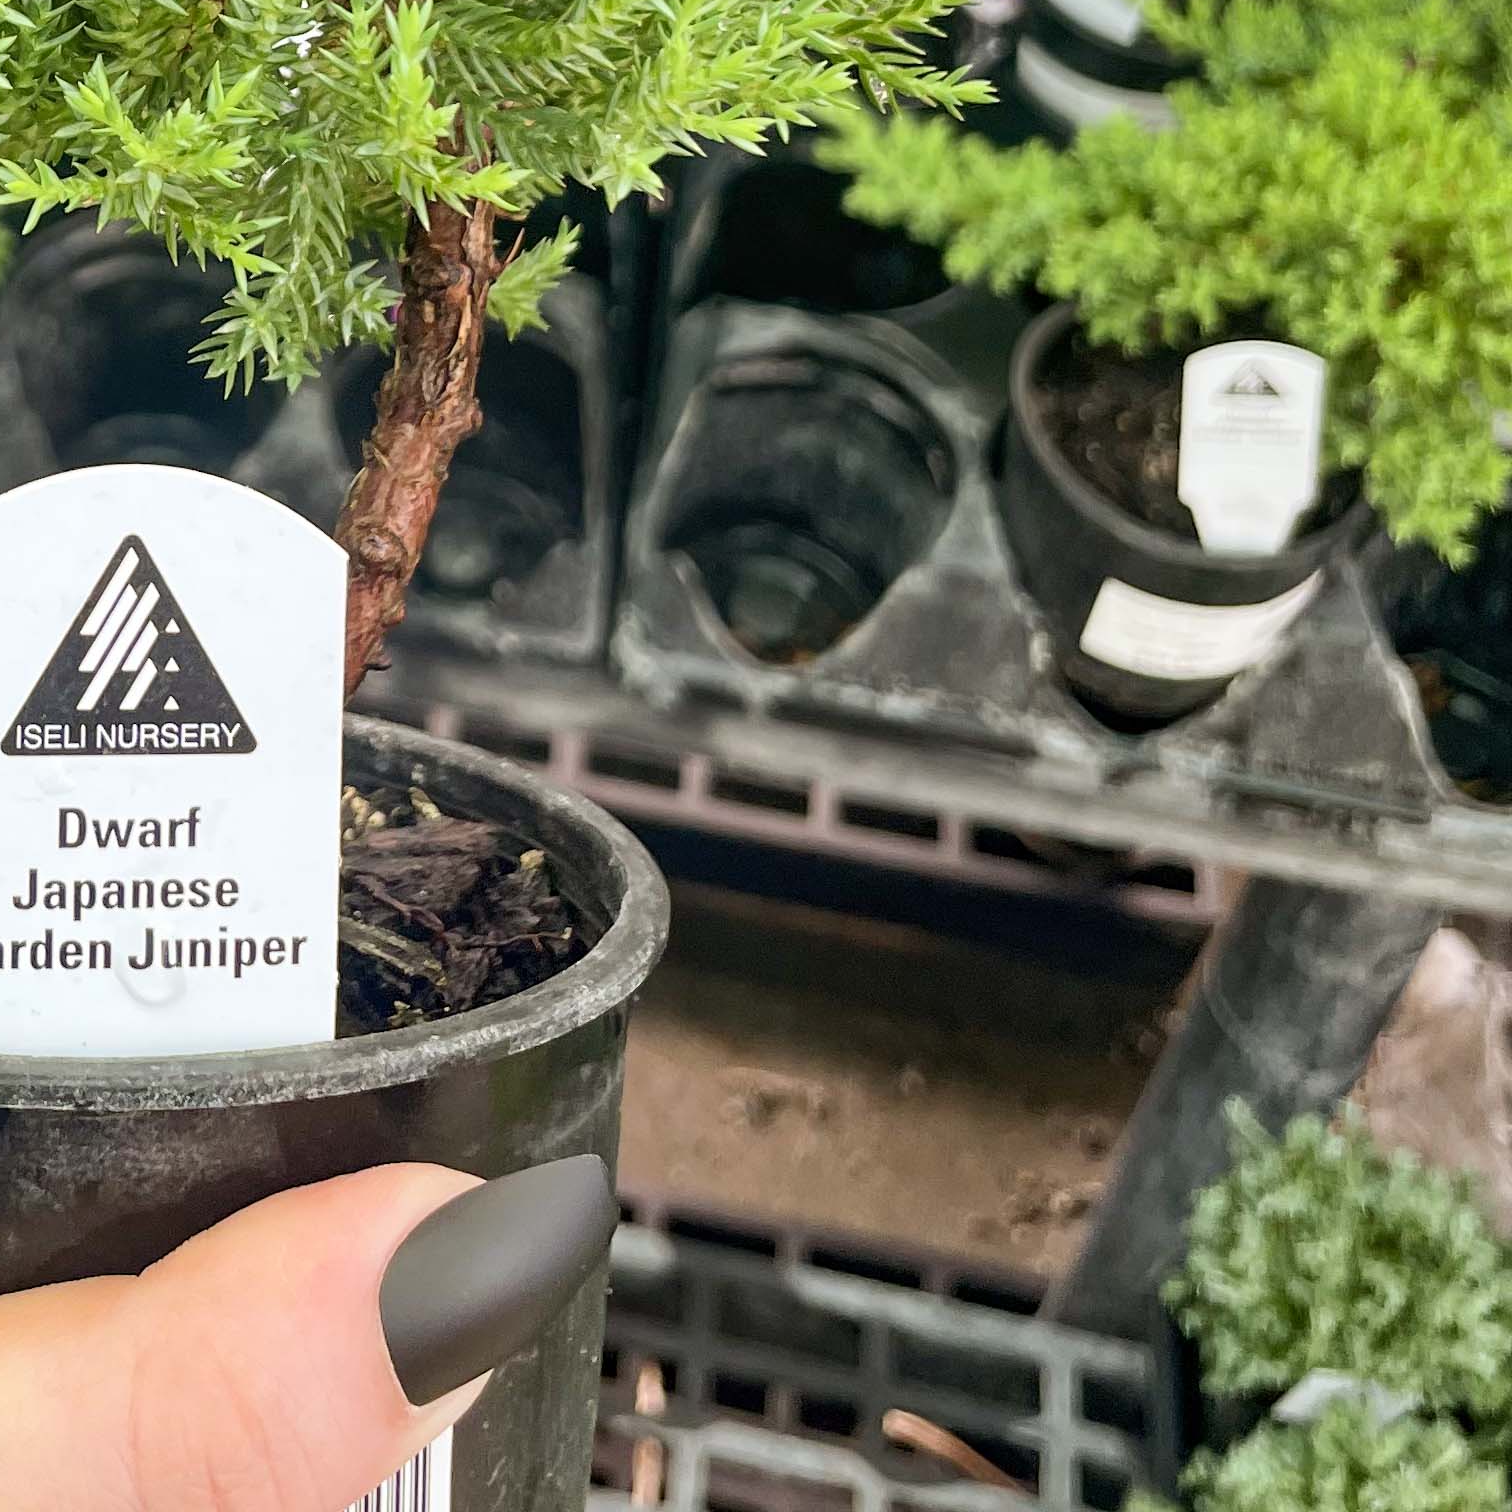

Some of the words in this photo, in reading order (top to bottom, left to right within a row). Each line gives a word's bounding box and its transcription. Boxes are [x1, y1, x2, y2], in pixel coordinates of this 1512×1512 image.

[15, 723, 88, 751] ISELI
[95, 722, 243, 750] NURSERY
[57, 807, 202, 849] Dwarf
[12, 868, 240, 923] Japanese
[127, 927, 308, 979] Juniper
